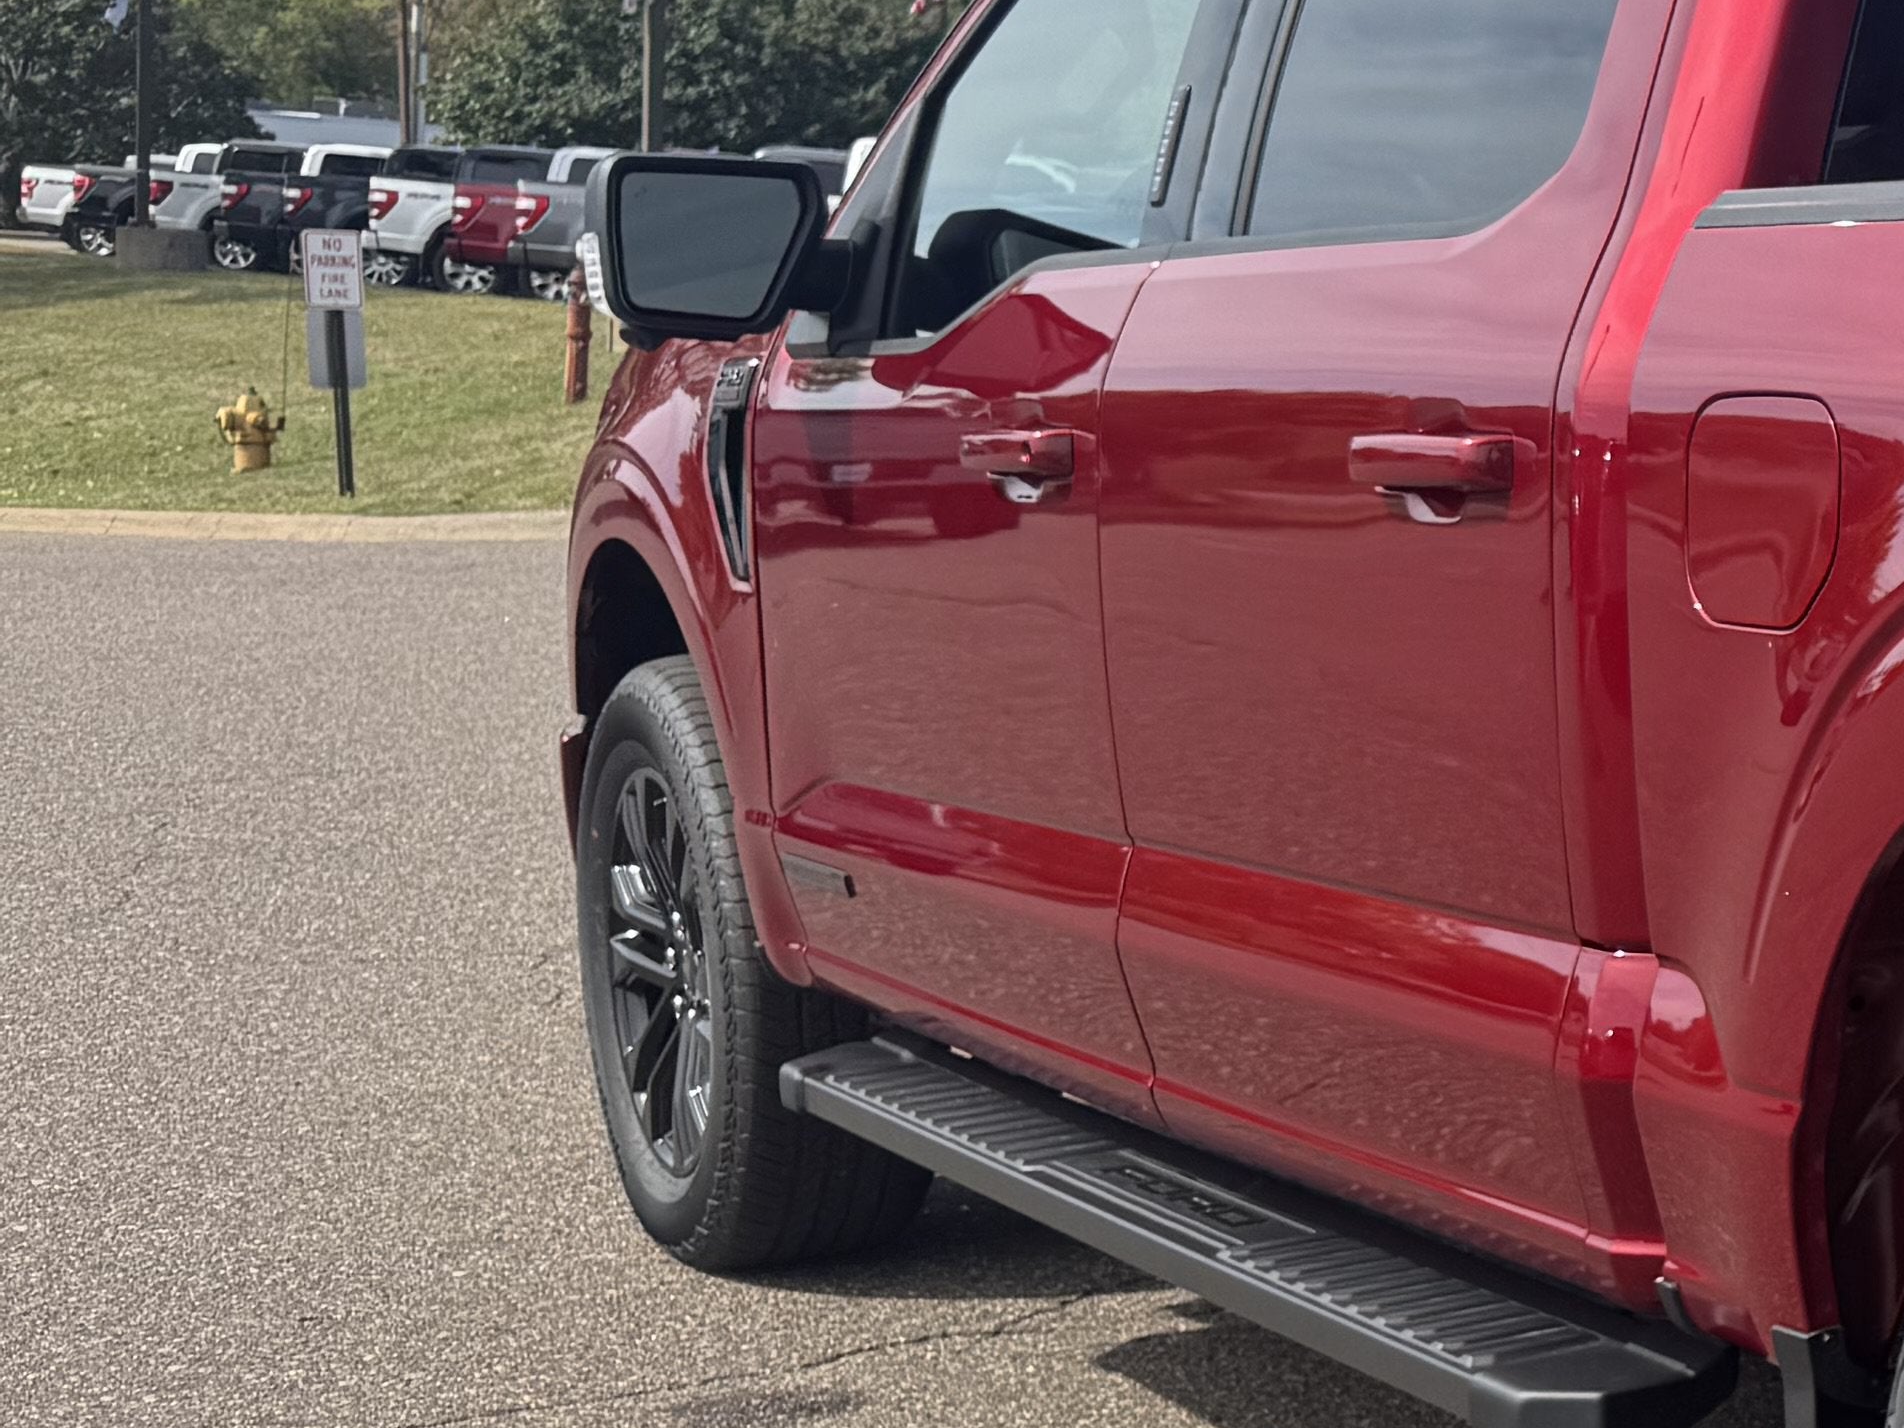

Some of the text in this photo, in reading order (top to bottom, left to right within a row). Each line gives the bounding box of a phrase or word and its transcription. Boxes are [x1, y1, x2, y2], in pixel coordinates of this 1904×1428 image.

[322, 237, 342, 253] NO
[310, 254, 356, 269] PARKING
[320, 273, 345, 285] FIRE
[319, 288, 348, 299] LANE
